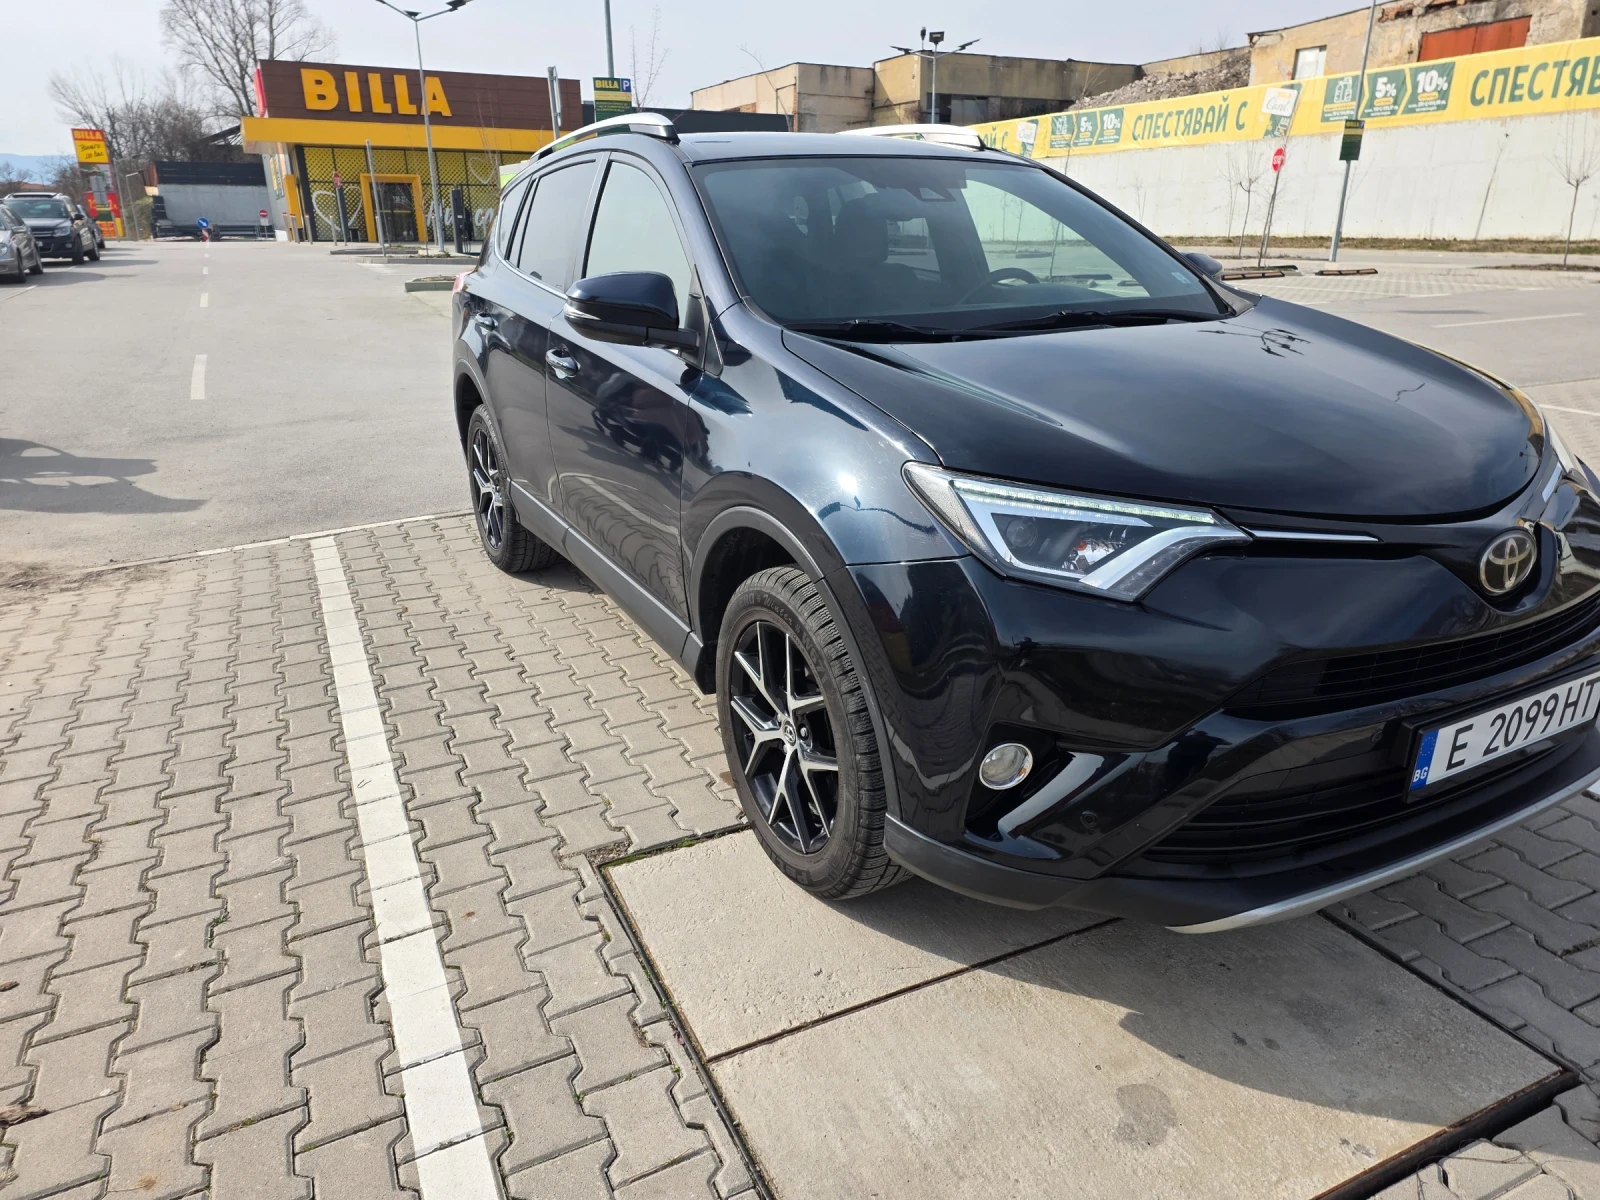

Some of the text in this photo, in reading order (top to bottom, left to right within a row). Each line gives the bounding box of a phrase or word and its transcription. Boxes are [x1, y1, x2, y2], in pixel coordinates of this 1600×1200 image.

[595, 80, 619, 89] BILLA
[1375, 76, 1397, 99] 5%
[1416, 69, 1448, 94] 10%
[300, 68, 452, 117] BILLA
[1080, 116, 1093, 133] 5%
[1103, 113, 1121, 130] 10%
[1132, 94, 1249, 141] СПЕСТЯВАЙ С
[73, 130, 103, 140] BILLA
[1413, 767, 1428, 782] BG
